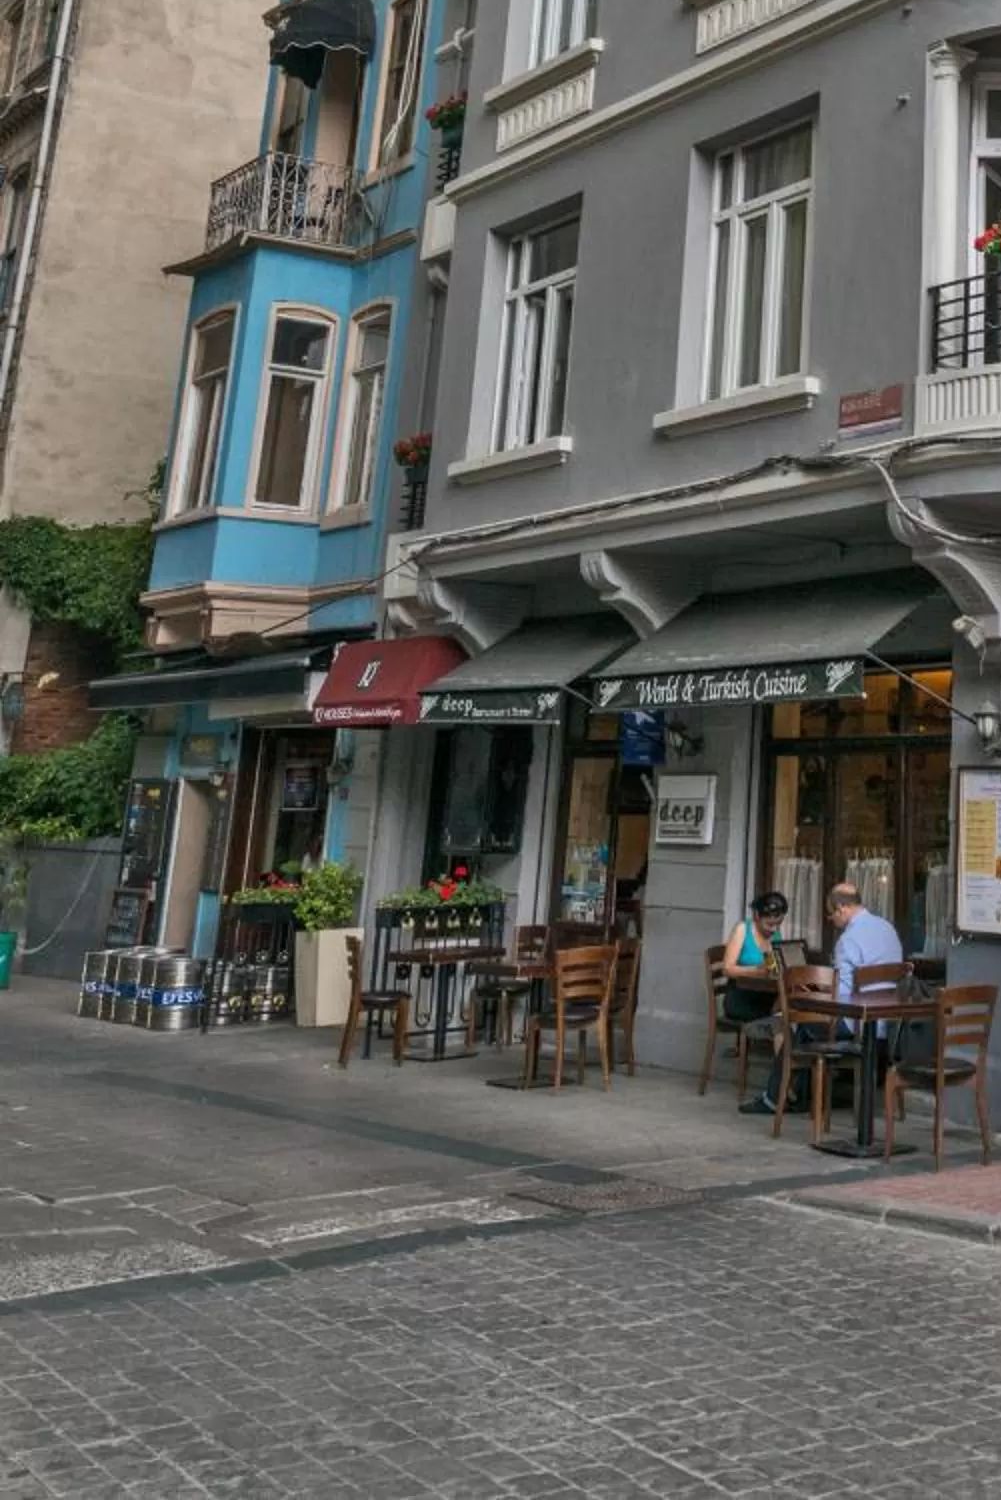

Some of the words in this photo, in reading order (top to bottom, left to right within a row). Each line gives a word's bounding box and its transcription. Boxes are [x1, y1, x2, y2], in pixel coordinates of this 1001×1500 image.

[635, 673, 678, 705] World
[681, 673, 696, 704] &
[699, 669, 750, 701] Turkish
[753, 668, 807, 700] Cuisine
